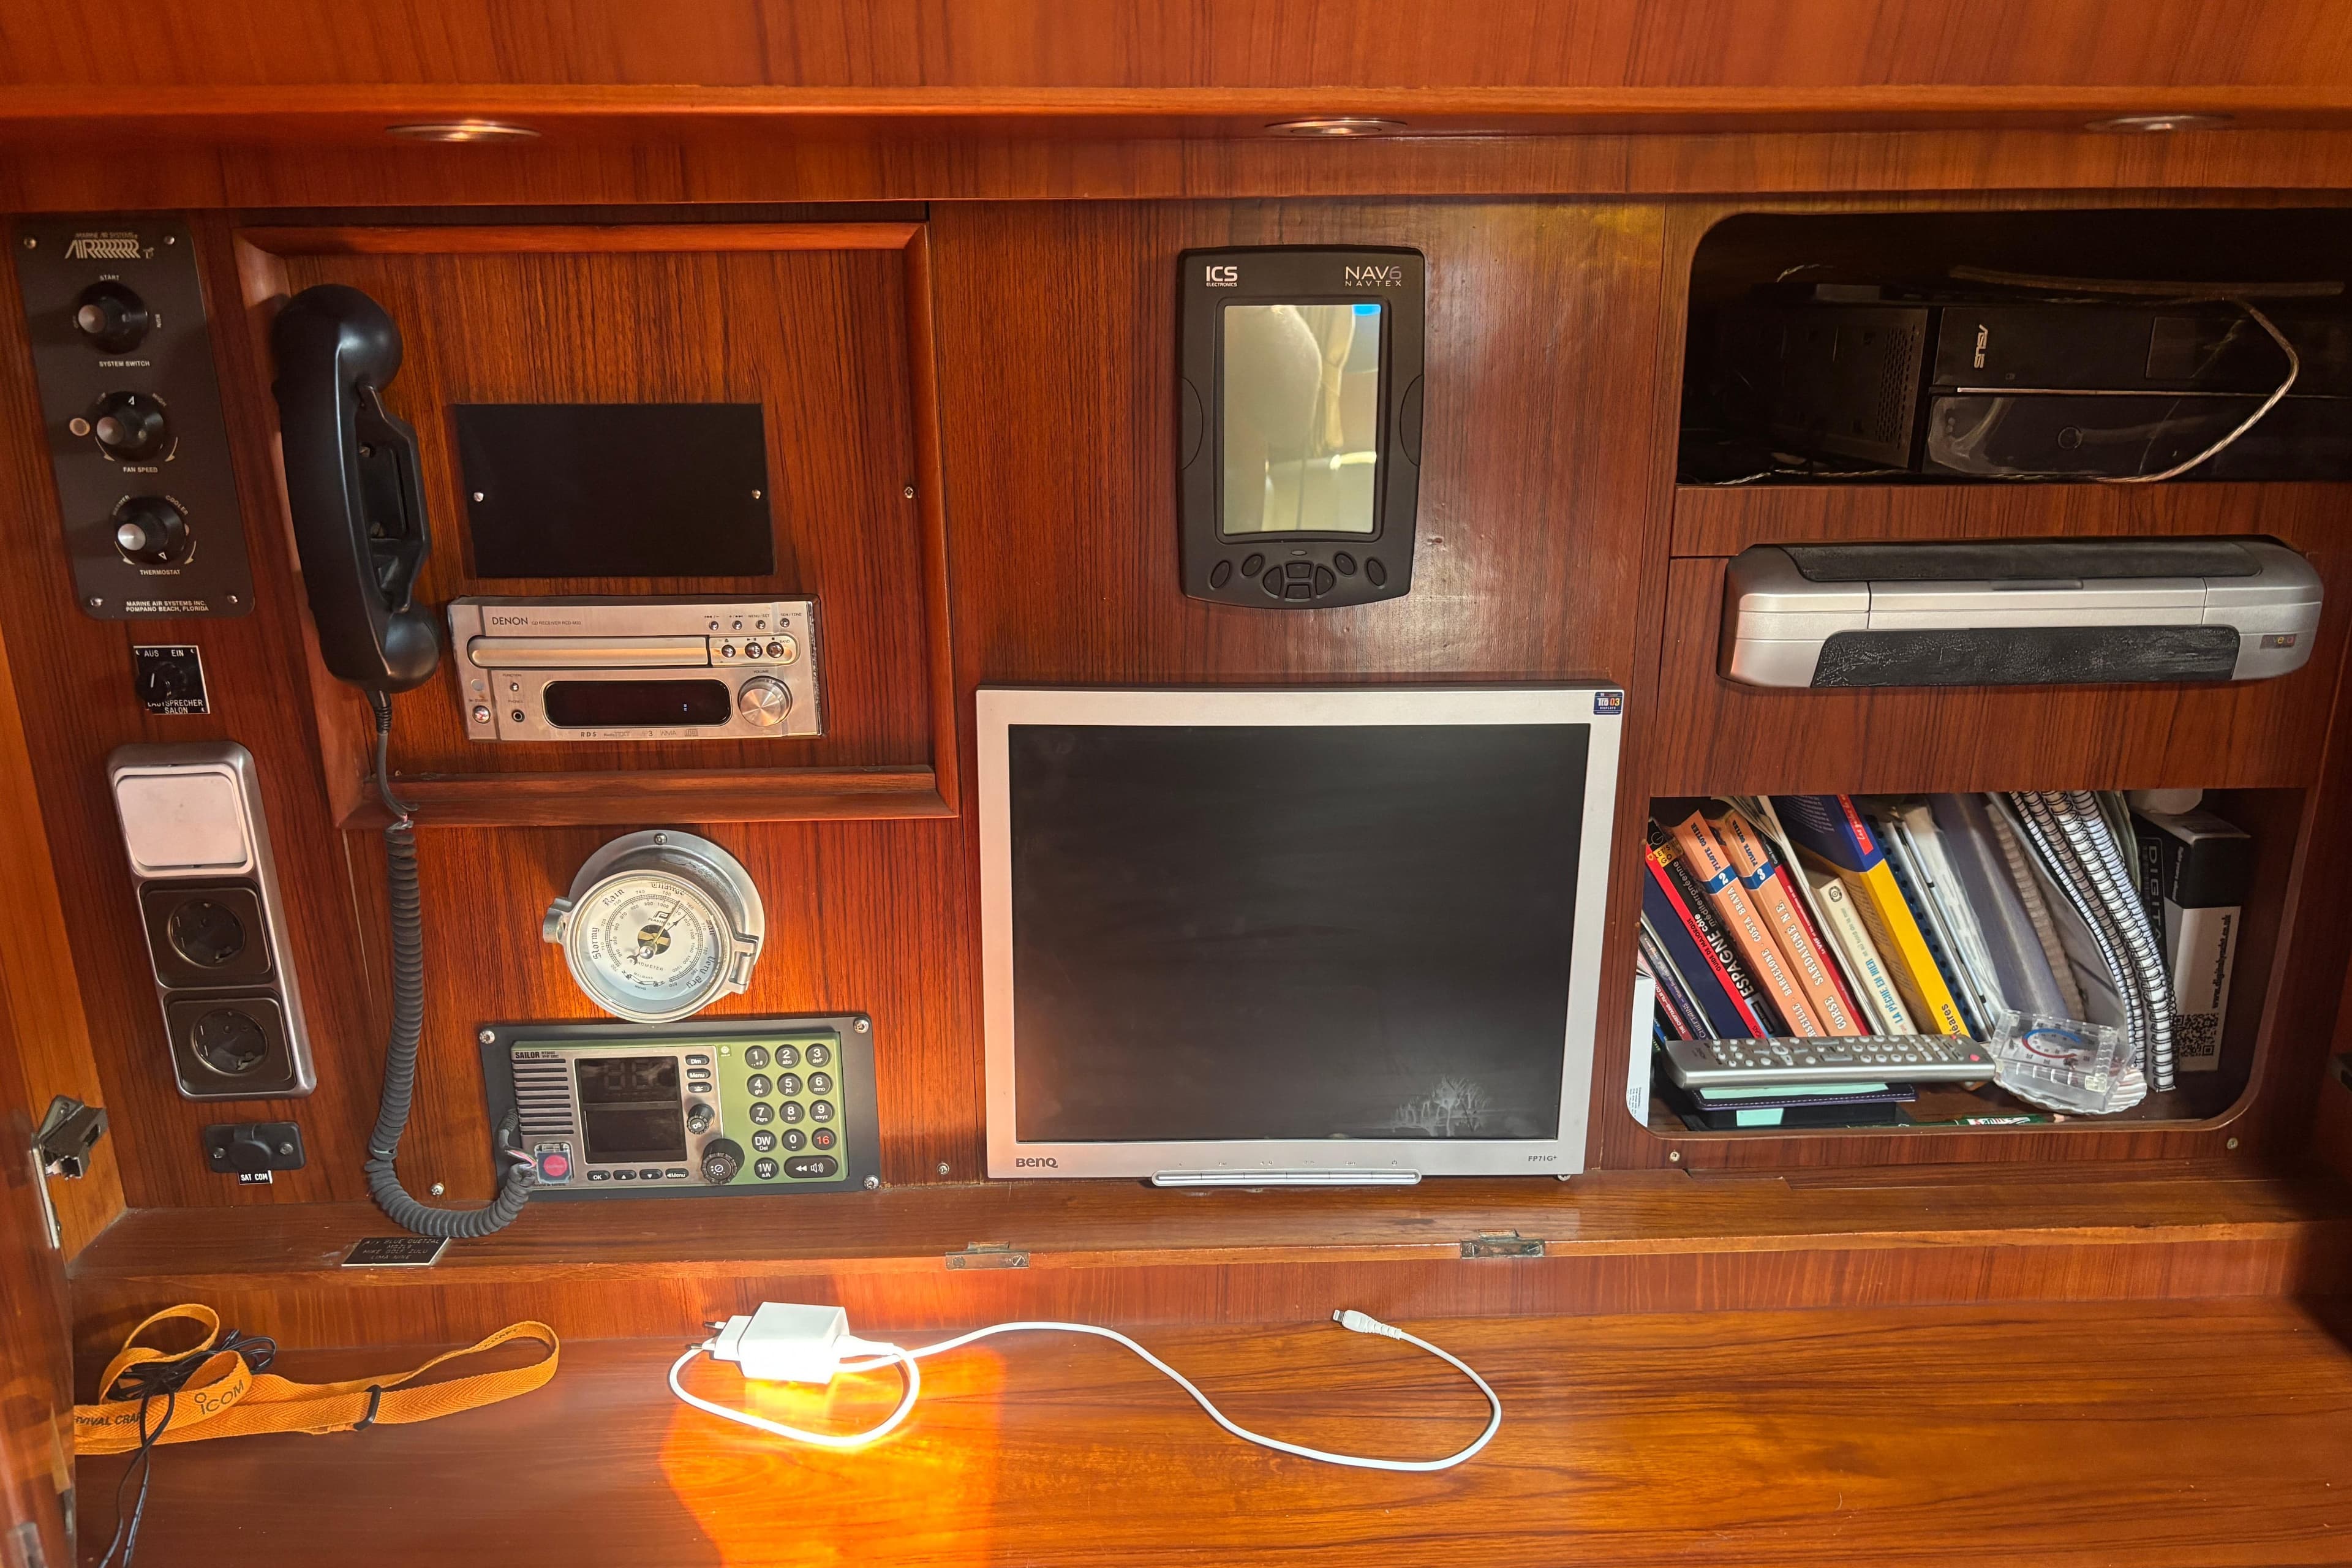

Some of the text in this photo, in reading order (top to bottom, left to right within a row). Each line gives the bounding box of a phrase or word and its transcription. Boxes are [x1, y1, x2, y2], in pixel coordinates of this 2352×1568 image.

[1206, 266, 1238, 282] ICS
[1345, 266, 1402, 280] NAV6
[1973, 324, 1988, 368] ASUS
[492, 617, 528, 625] DENON
[1654, 844, 1671, 859] LET'S
[1691, 823, 1722, 871] PILOTE COTIER
[1661, 854, 1672, 864] GO
[1744, 843, 1758, 867] PILOTE
[1719, 872, 1728, 885] 2
[1757, 868, 1765, 881] 3
[602, 889, 625, 907] Rain
[2149, 845, 2162, 939] DIGITA
[1727, 886, 1746, 916] BRAVA
[1776, 900, 1791, 923] N.E.
[648, 918, 671, 926] PLASTIO
[1744, 916, 1761, 942] COSTA
[592, 927, 601, 959] Stormy
[1687, 918, 1721, 971] GUIDE DE MAJORQUE
[1814, 937, 1823, 949] VHF
[1786, 924, 1823, 986] SARDAIGNE
[629, 959, 663, 971] BROMETER
[1707, 930, 1755, 997] ESPAGNE
[1865, 958, 1880, 976] MER
[1762, 948, 1793, 997] BARCELONE
[1874, 976, 1885, 988] EN
[1879, 988, 1898, 1013] PÊCHE
[1792, 1003, 1818, 1036] RSEILLE
[1824, 996, 1847, 1030] CORSE
[1891, 1011, 1904, 1023] LA
[1682, 1003, 1706, 1039] CHIEFTAINS
[752, 1050, 758, 1060] 1
[782, 1049, 791, 1059] 2
[813, 1048, 821, 1058] 3
[755, 1079, 762, 1088] 4
[785, 1078, 793, 1087] 5
[815, 1077, 823, 1086] 6
[757, 1107, 764, 1116] 7
[787, 1106, 795, 1115] 8
[818, 1104, 825, 1114] 9
[755, 1136, 771, 1145] DW
[790, 1134, 797, 1144] 0
[817, 1136, 830, 1144] 16
[758, 1163, 772, 1172] 1W
[1016, 1158, 1058, 1168] BenQ
